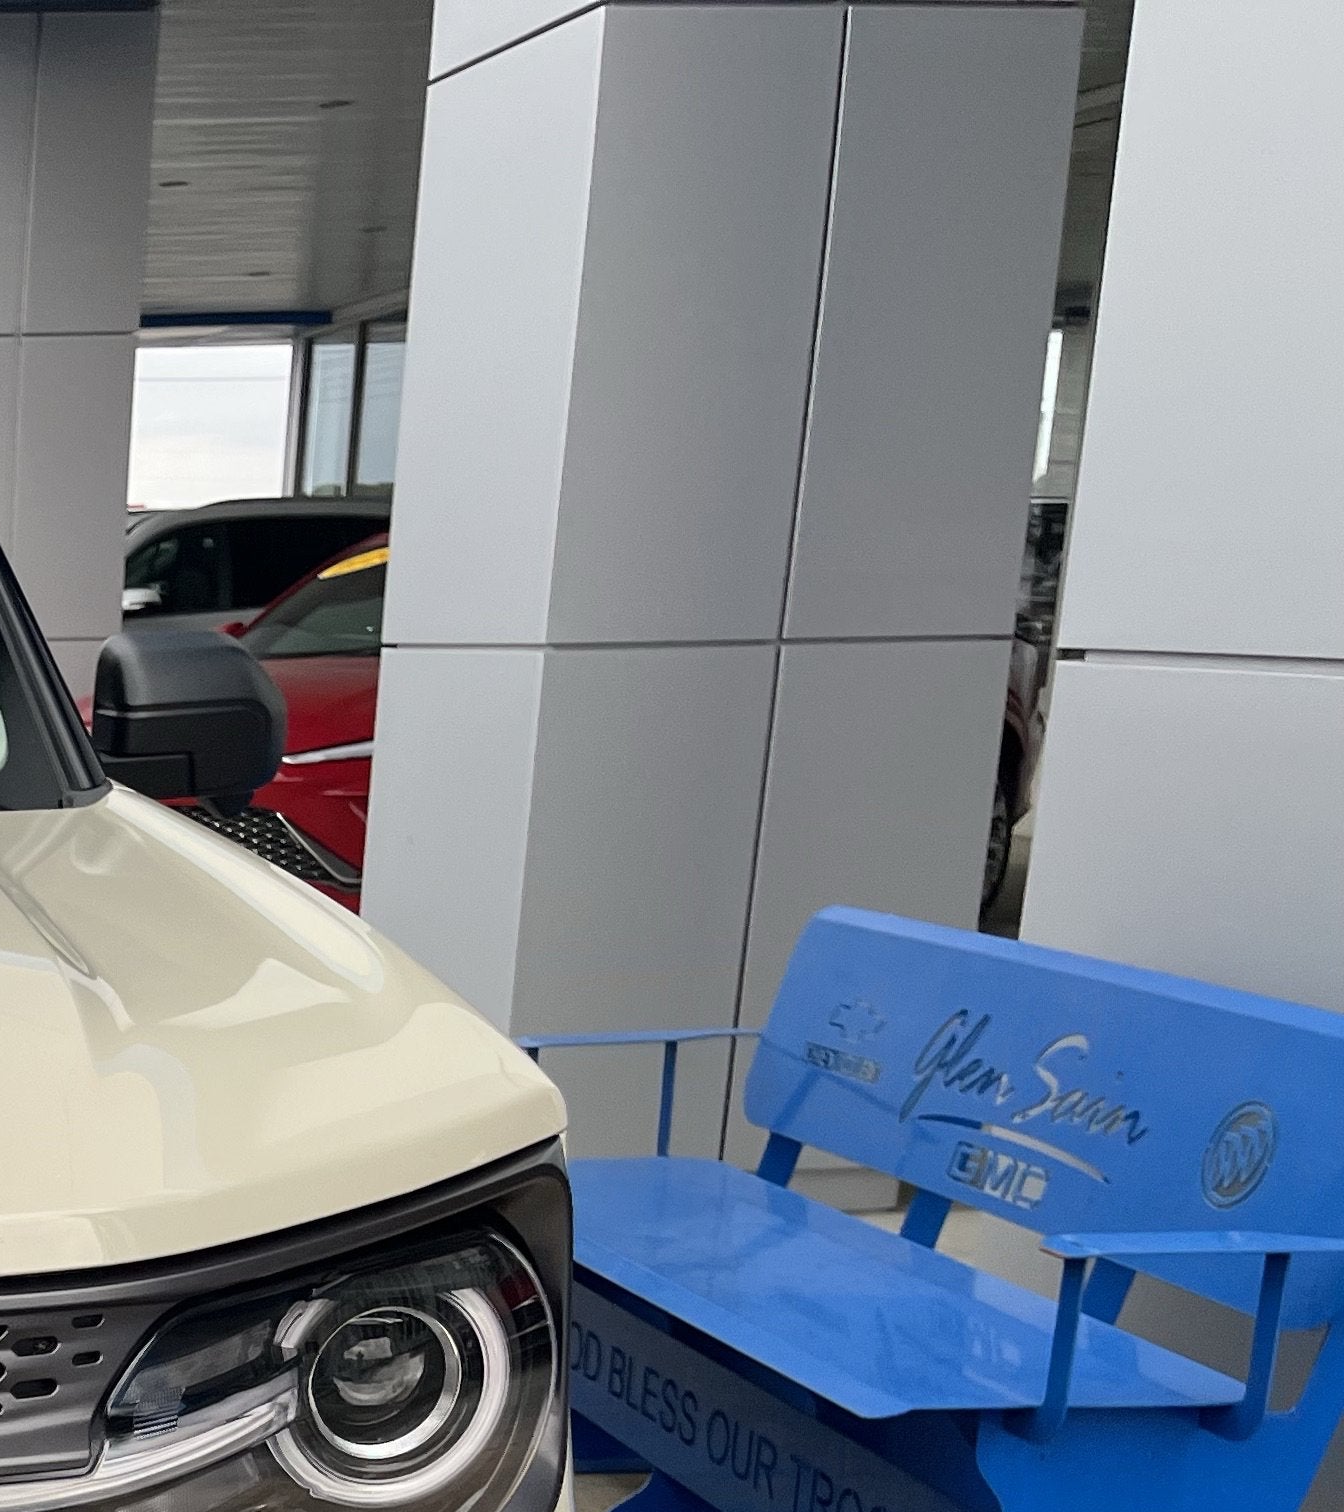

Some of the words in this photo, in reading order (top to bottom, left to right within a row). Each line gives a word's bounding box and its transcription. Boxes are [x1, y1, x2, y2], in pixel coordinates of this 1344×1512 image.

[898, 1008, 1015, 1124] Glen
[1011, 1032, 1149, 1145] Sain
[946, 1140, 1050, 1210] GMC
[608, 1345, 698, 1446] BLESS
[706, 1408, 778, 1500] OUR
